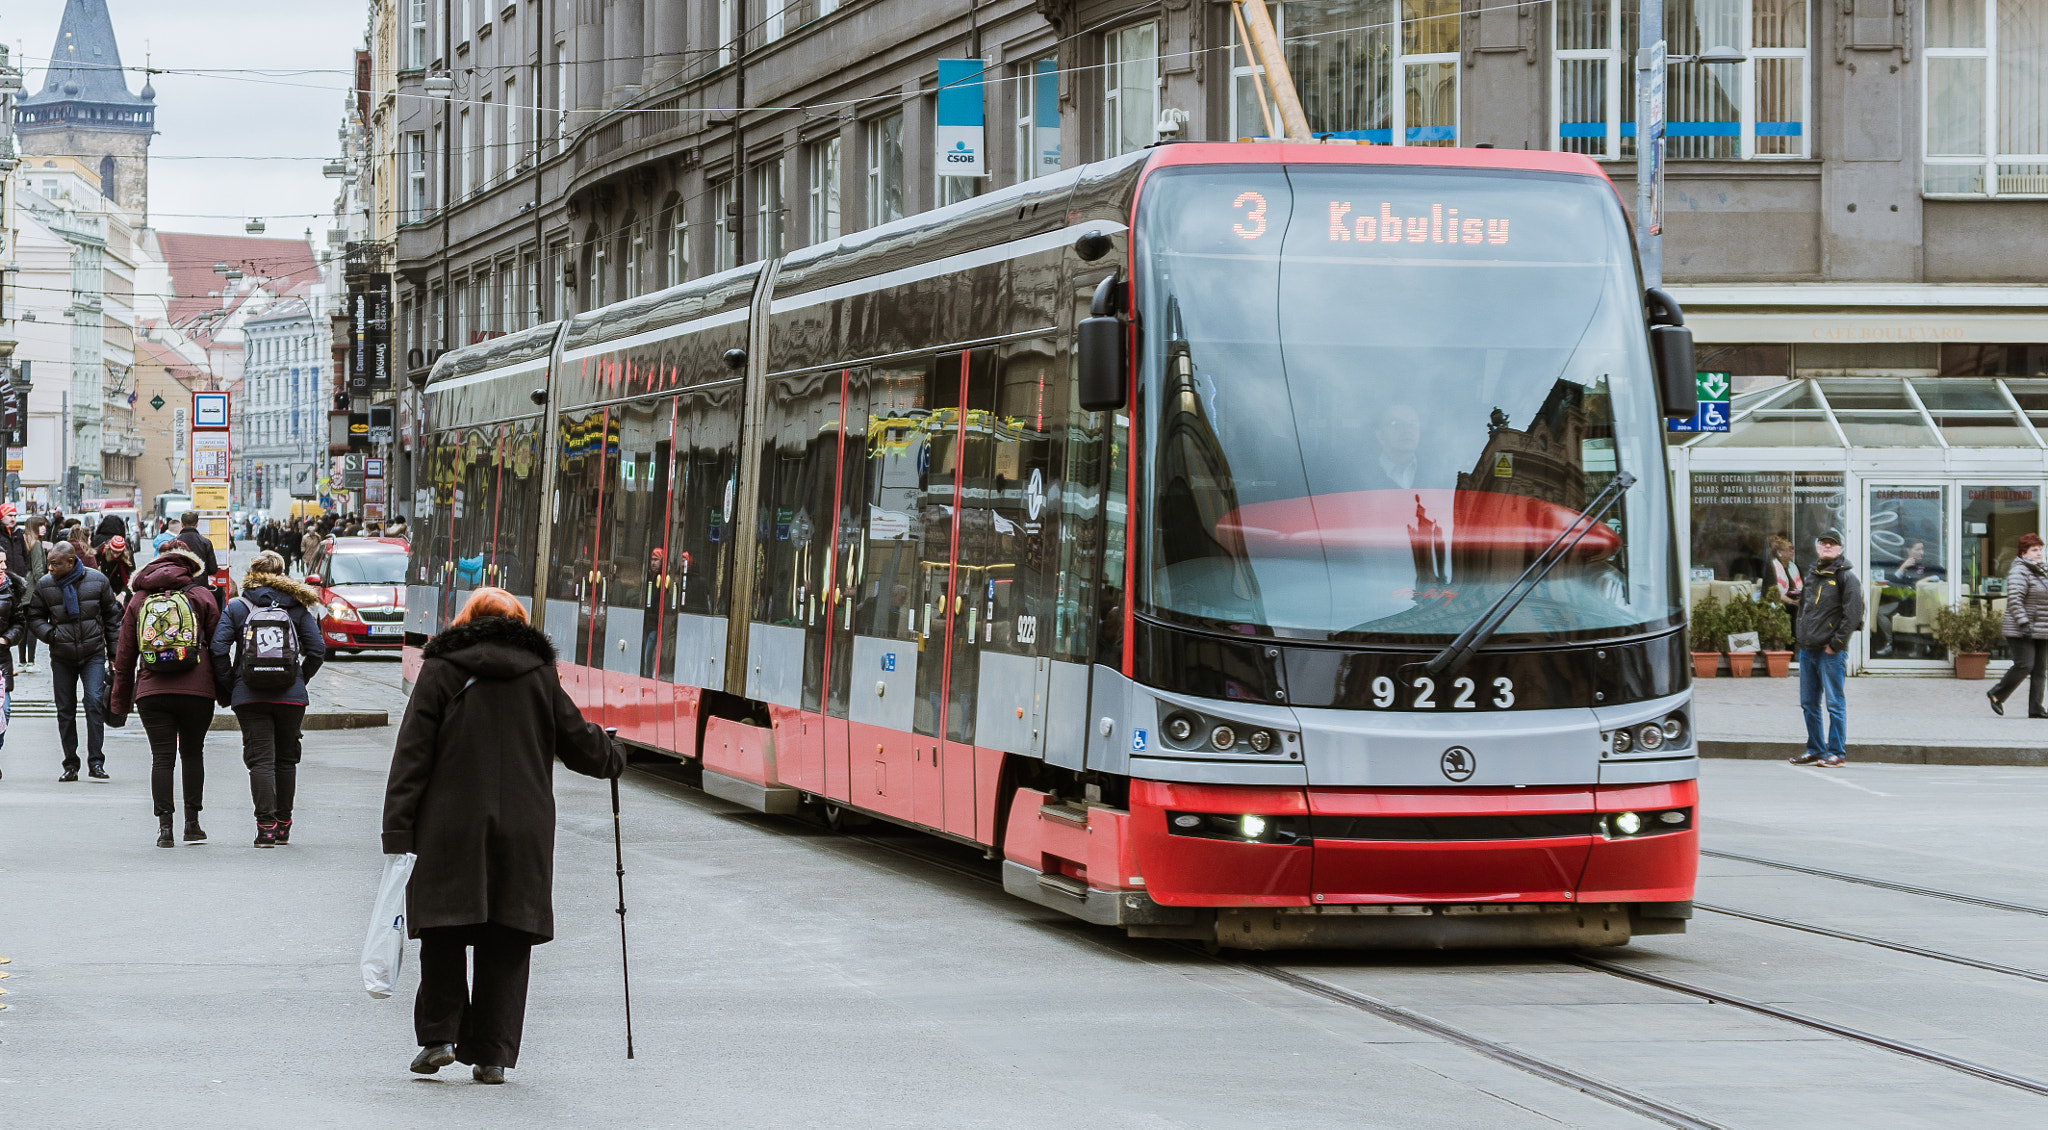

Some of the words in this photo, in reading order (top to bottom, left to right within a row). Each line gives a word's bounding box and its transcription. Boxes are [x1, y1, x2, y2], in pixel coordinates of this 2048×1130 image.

[947, 153, 975, 163] ČSOB
[1232, 191, 1267, 240] 3
[1328, 200, 1510, 245] Kobylisy
[1811, 324, 1856, 340] CAFÉ
[1860, 327, 1965, 340] BOULEVARD
[356, 339, 364, 372] Centrum
[375, 343, 386, 379] LANGHANS
[176, 409, 184, 427] FOOD
[176, 429, 184, 451] INDIAN
[1694, 475, 1717, 483] COFFEE
[1721, 475, 1751, 483] COCTAILS
[1755, 475, 1779, 483] SALADS
[1783, 475, 1803, 483] PASTA
[1806, 475, 1842, 483] BREAKFAST
[1694, 486, 1719, 494] SALADS
[1723, 486, 1743, 494] PASTA
[1748, 486, 1784, 494] BREAKFAST
[1898, 490, 1940, 500] BOULEVARD
[1990, 490, 2033, 500] BOULEVARD
[1694, 496, 1717, 504] COFFEE
[1721, 496, 1751, 504] COCTAILS
[1755, 496, 1779, 504] SALADS
[1783, 496, 1803, 504] PASTA
[1806, 496, 1842, 504] BREAKFAST
[1016, 614, 1037, 644] 9223
[1371, 676, 1516, 709] 9223
